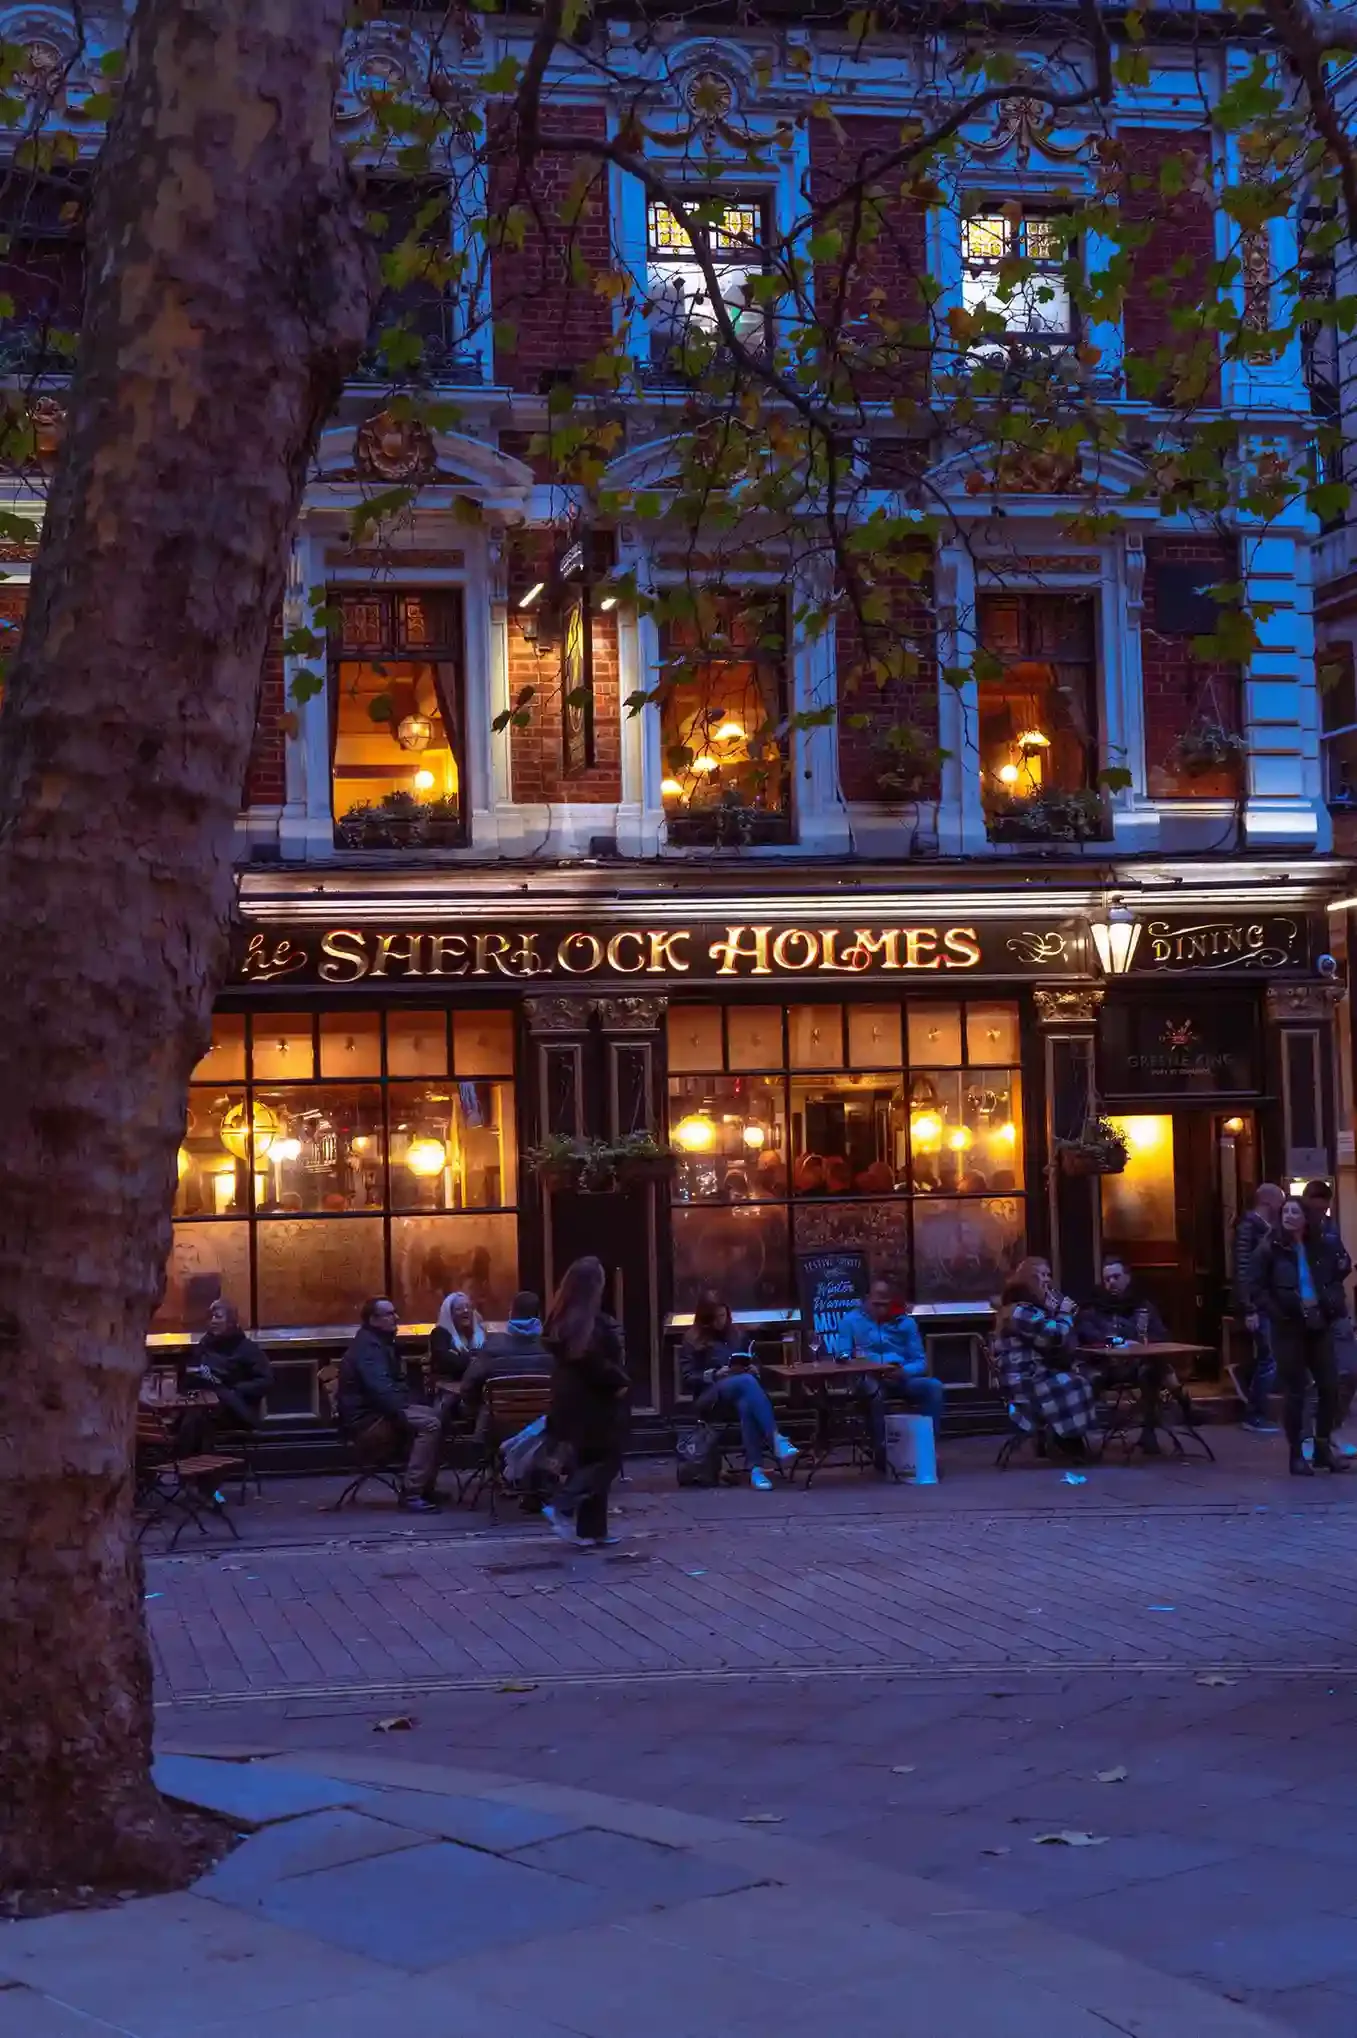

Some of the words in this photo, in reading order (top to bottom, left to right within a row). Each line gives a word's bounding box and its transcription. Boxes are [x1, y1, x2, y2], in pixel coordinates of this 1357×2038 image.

[240, 932, 307, 980] he
[317, 930, 691, 983] SHERLOCK
[708, 926, 981, 974] HOLMES
[1151, 924, 1265, 962] DINING
